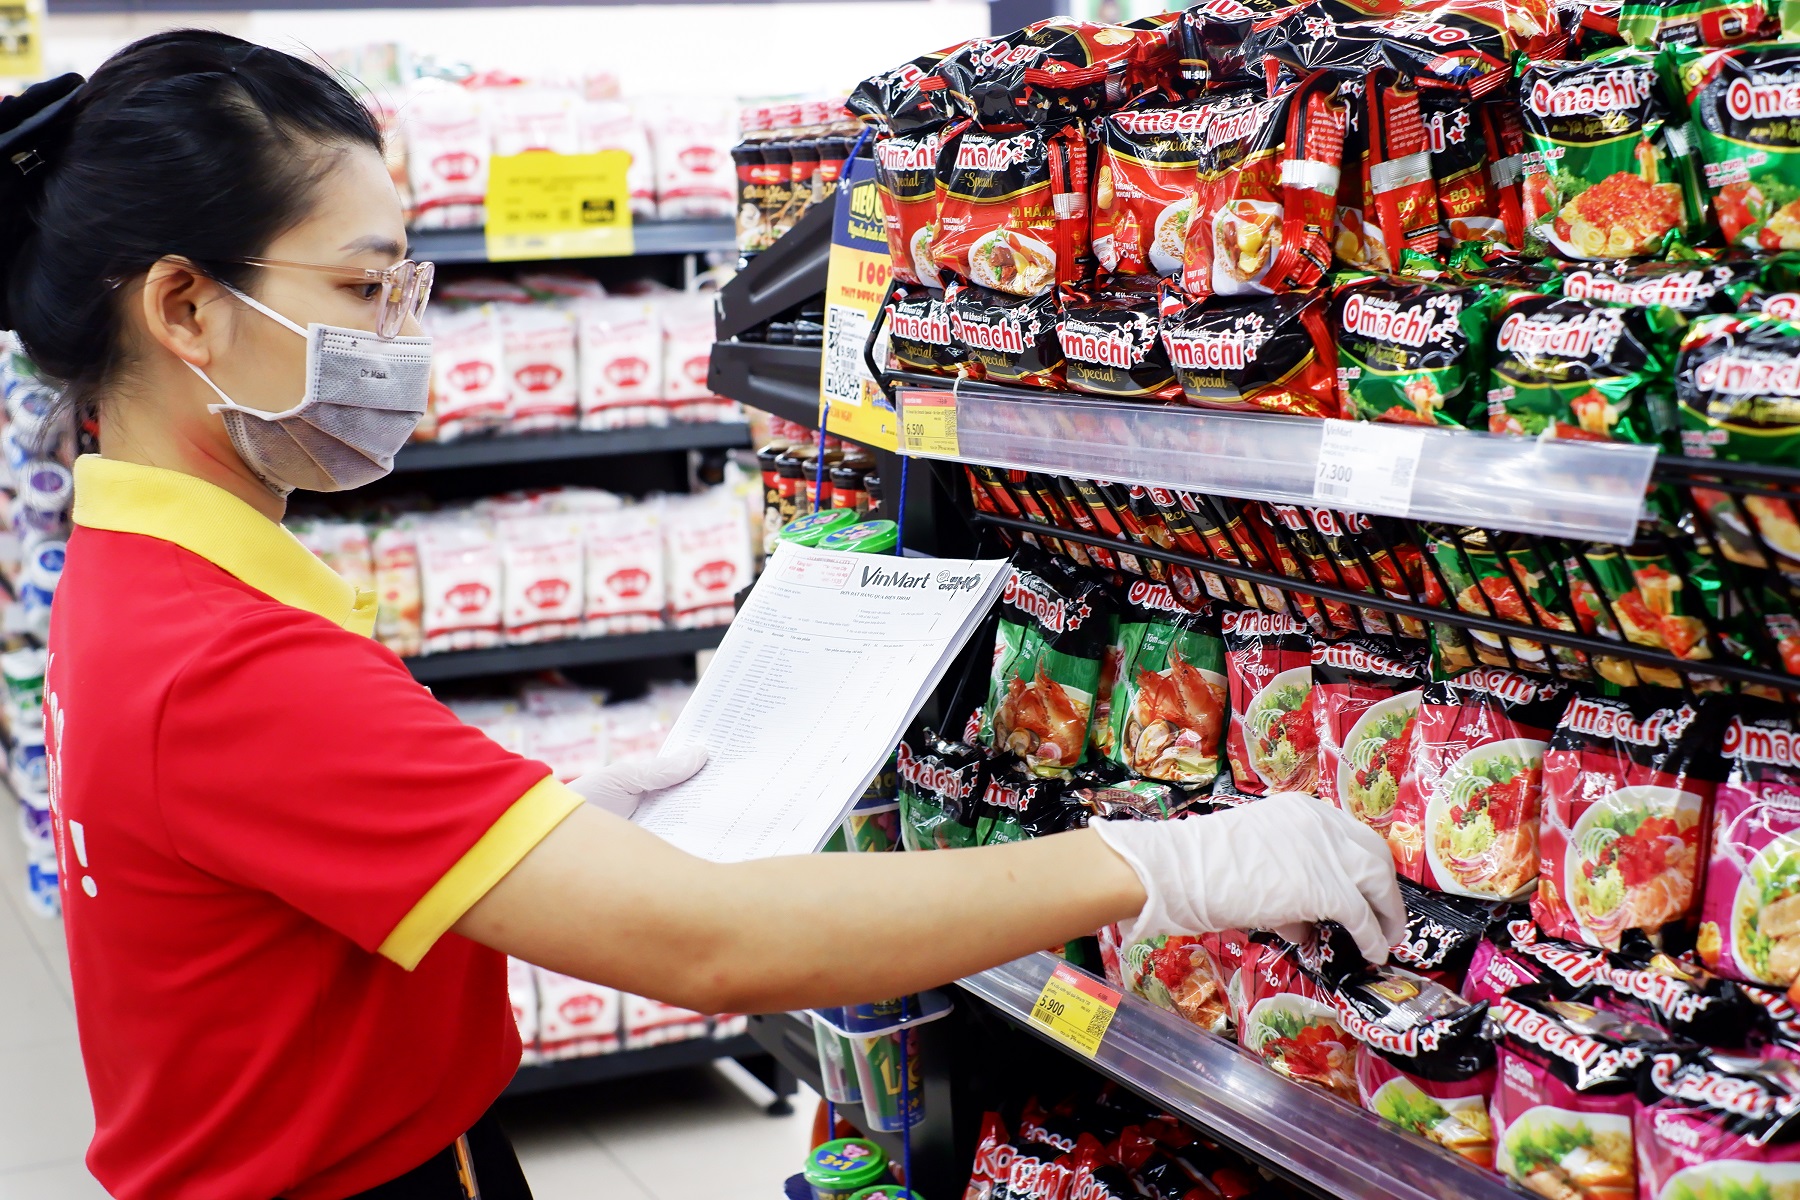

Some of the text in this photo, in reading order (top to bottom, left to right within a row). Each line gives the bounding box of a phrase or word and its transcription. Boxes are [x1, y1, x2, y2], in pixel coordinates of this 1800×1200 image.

[1530, 70, 1641, 117] Omachi
[1726, 77, 1800, 121] Oma
[1206, 106, 1261, 150] Omach
[875, 138, 937, 171] Omahi
[957, 139, 1012, 172] mach
[951, 311, 1025, 353] Omachi
[1343, 293, 1437, 348] Omachi
[1075, 363, 1117, 383] Special
[1187, 372, 1228, 391] Special
[1694, 346, 1800, 397] Omac
[906, 423, 925, 436] 6.500
[1319, 462, 1353, 483] 7.300
[860, 565, 931, 589] VinMart
[1002, 573, 1066, 633] Omac
[1146, 633, 1159, 644] Tôm
[1450, 664, 1538, 705] machi
[1721, 714, 1800, 769] Oma
[994, 830, 1009, 843] Tôm
[1487, 955, 1519, 987] Sườn
[1593, 950, 1690, 1020] machi
[1039, 994, 1065, 1017] 5.900
[1334, 990, 1418, 1058] machi
[1501, 997, 1607, 1068] machi
[818, 1154, 856, 1171] 3+1
